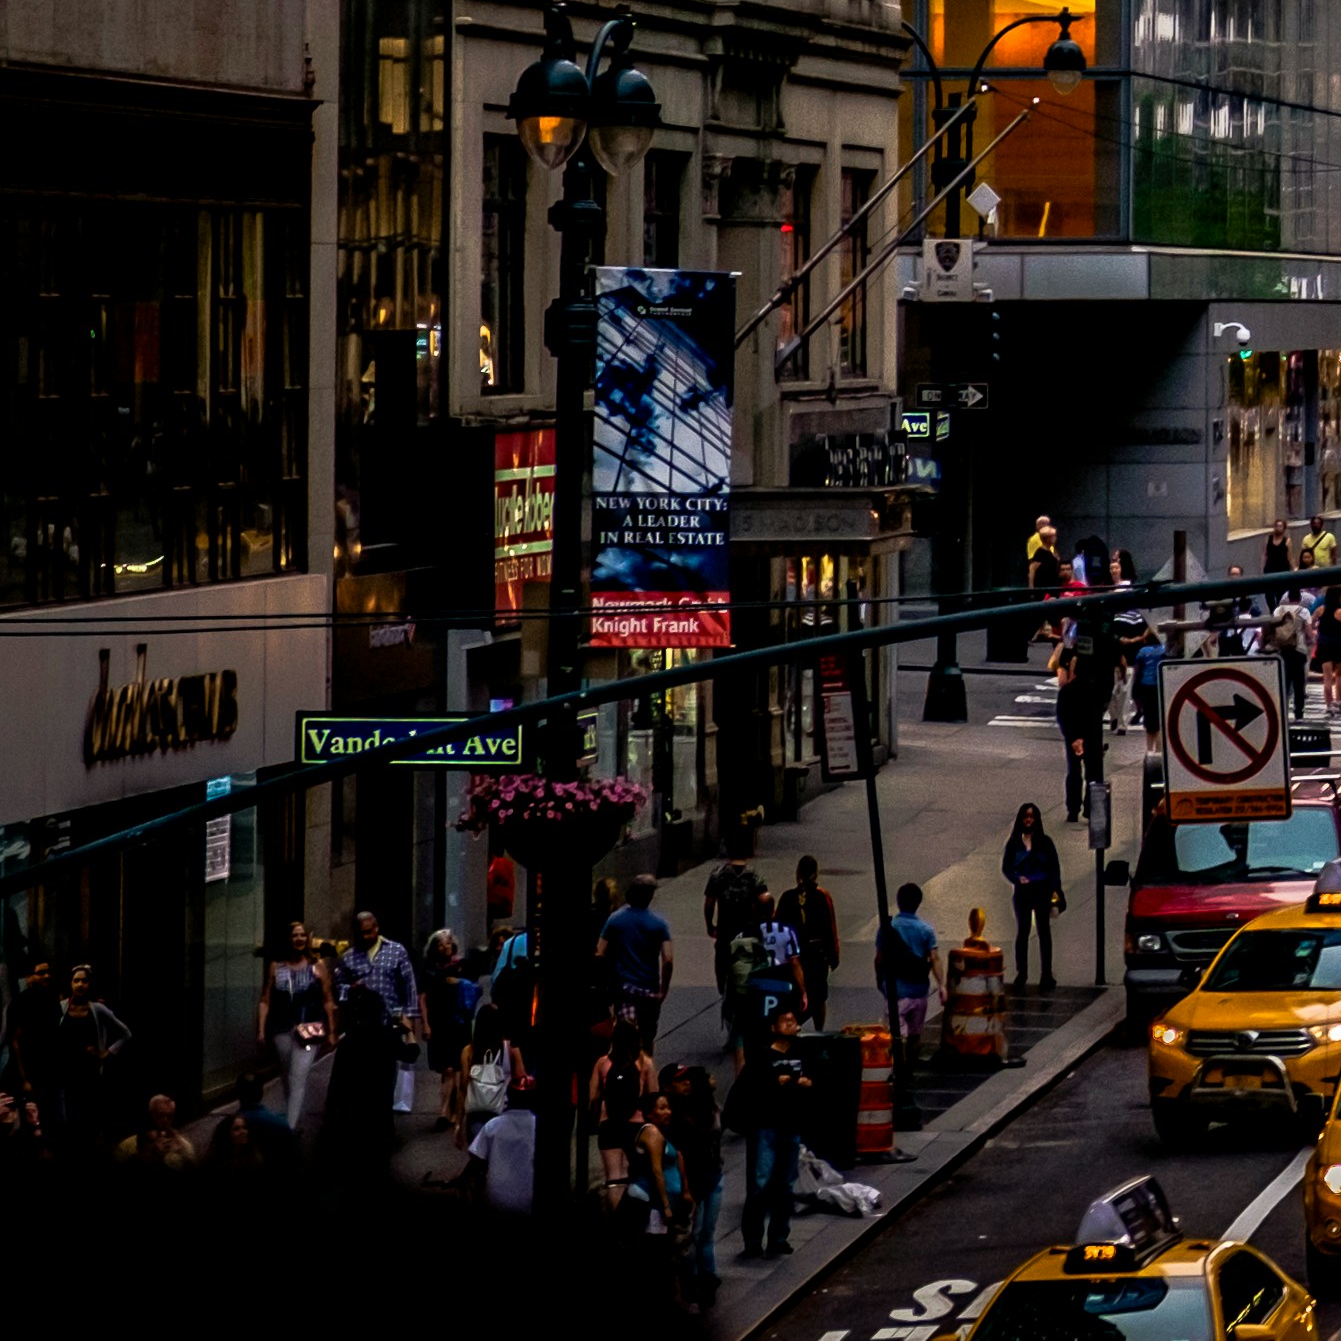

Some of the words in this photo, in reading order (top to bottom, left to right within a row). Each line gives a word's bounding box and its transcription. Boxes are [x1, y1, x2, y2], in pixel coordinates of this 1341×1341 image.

[596, 497, 631, 510] NEW
[636, 498, 681, 511] YORK
[685, 498, 728, 512] CITY:
[622, 515, 633, 527] A
[638, 515, 700, 528] LEADER
[600, 532, 619, 544] IN
[624, 532, 664, 545] REAL
[668, 532, 725, 545] ESTATE
[592, 618, 648, 636] Knight
[653, 618, 700, 634] Frank
[462, 735, 517, 756] Ave
